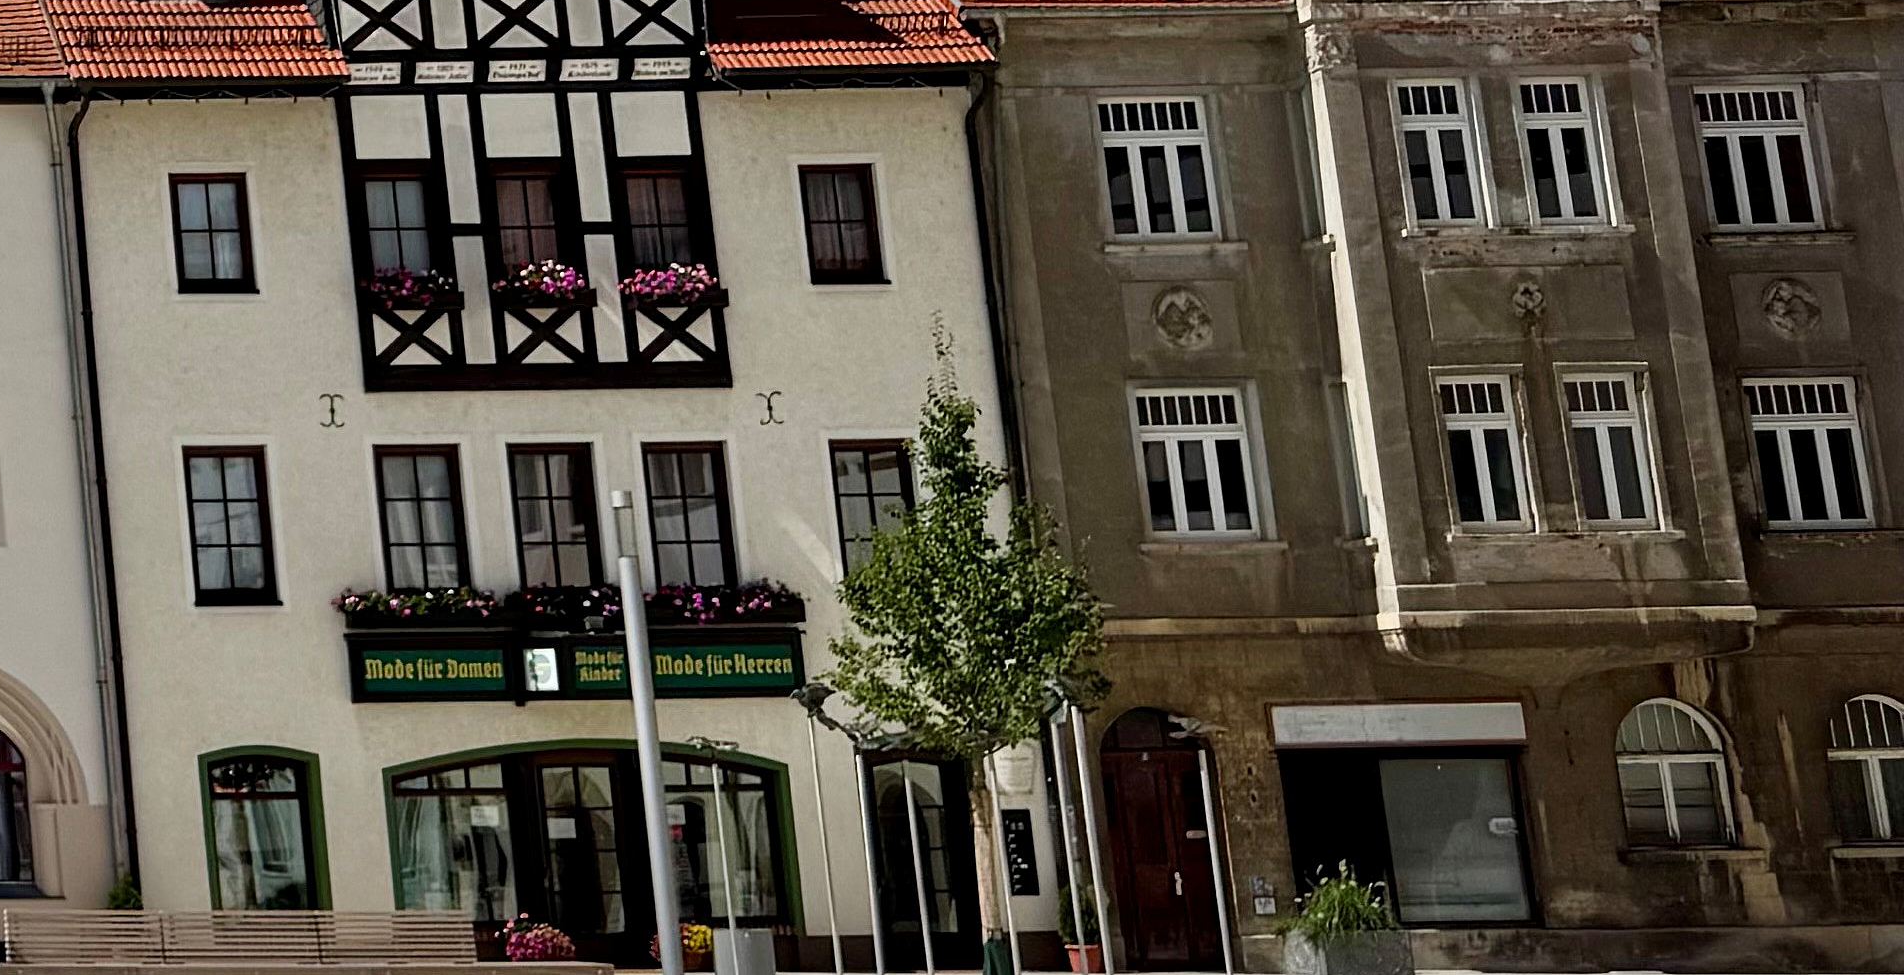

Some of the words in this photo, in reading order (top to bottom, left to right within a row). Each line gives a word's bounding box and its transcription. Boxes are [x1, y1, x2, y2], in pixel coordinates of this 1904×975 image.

[365, 659, 414, 679] Mode
[418, 658, 442, 681] für
[446, 658, 503, 679] Damen
[655, 654, 703, 675] Mode
[706, 654, 732, 677] für
[734, 653, 792, 674] Herren
